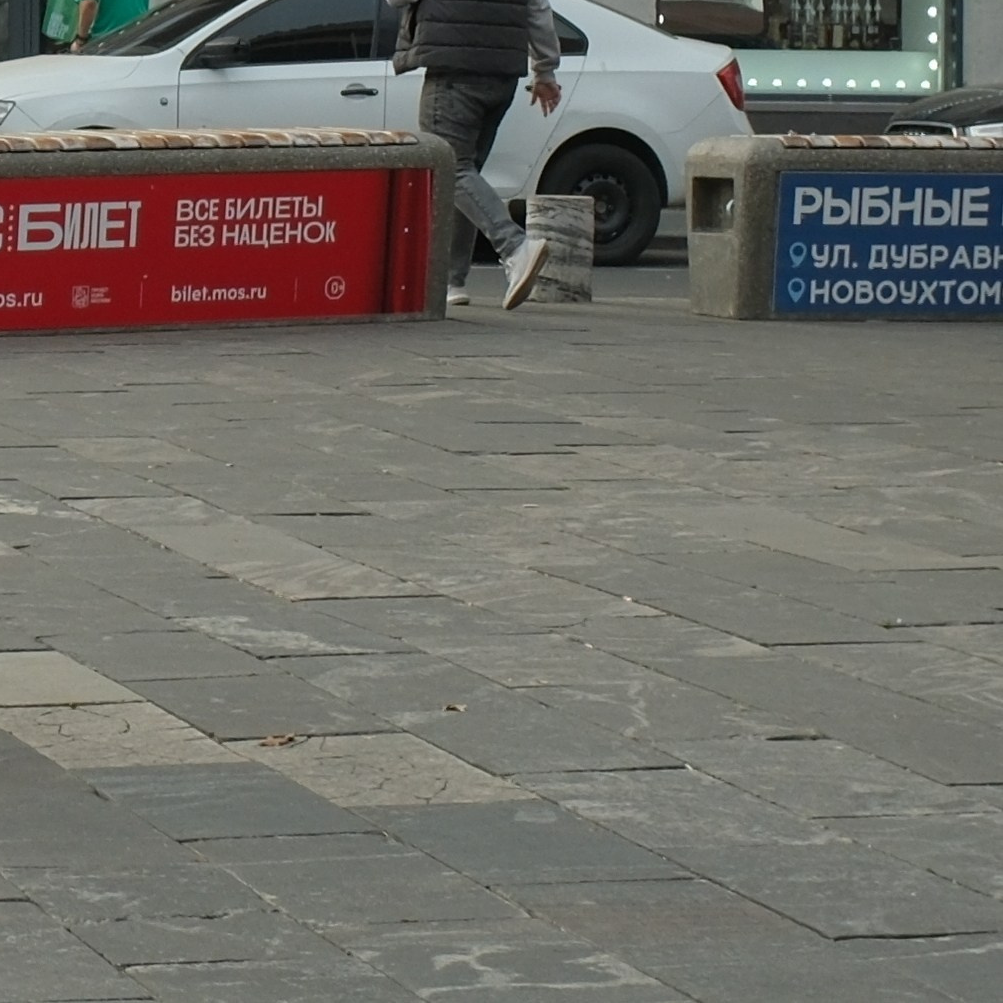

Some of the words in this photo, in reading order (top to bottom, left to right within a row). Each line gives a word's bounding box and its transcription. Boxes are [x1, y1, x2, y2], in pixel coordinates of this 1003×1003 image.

[177, 198, 220, 222] ВСЕ
[225, 195, 323, 220] БИЛЕТЫ
[793, 184, 991, 227] РЫБНЫЕ
[17, 200, 143, 252] БИЛЕТ
[174, 224, 215, 248] БЕЗ
[222, 221, 337, 249] НАЦЕНОК
[811, 244, 858, 269] УЛ.
[171, 285, 267, 302] bilet.mos.ru
